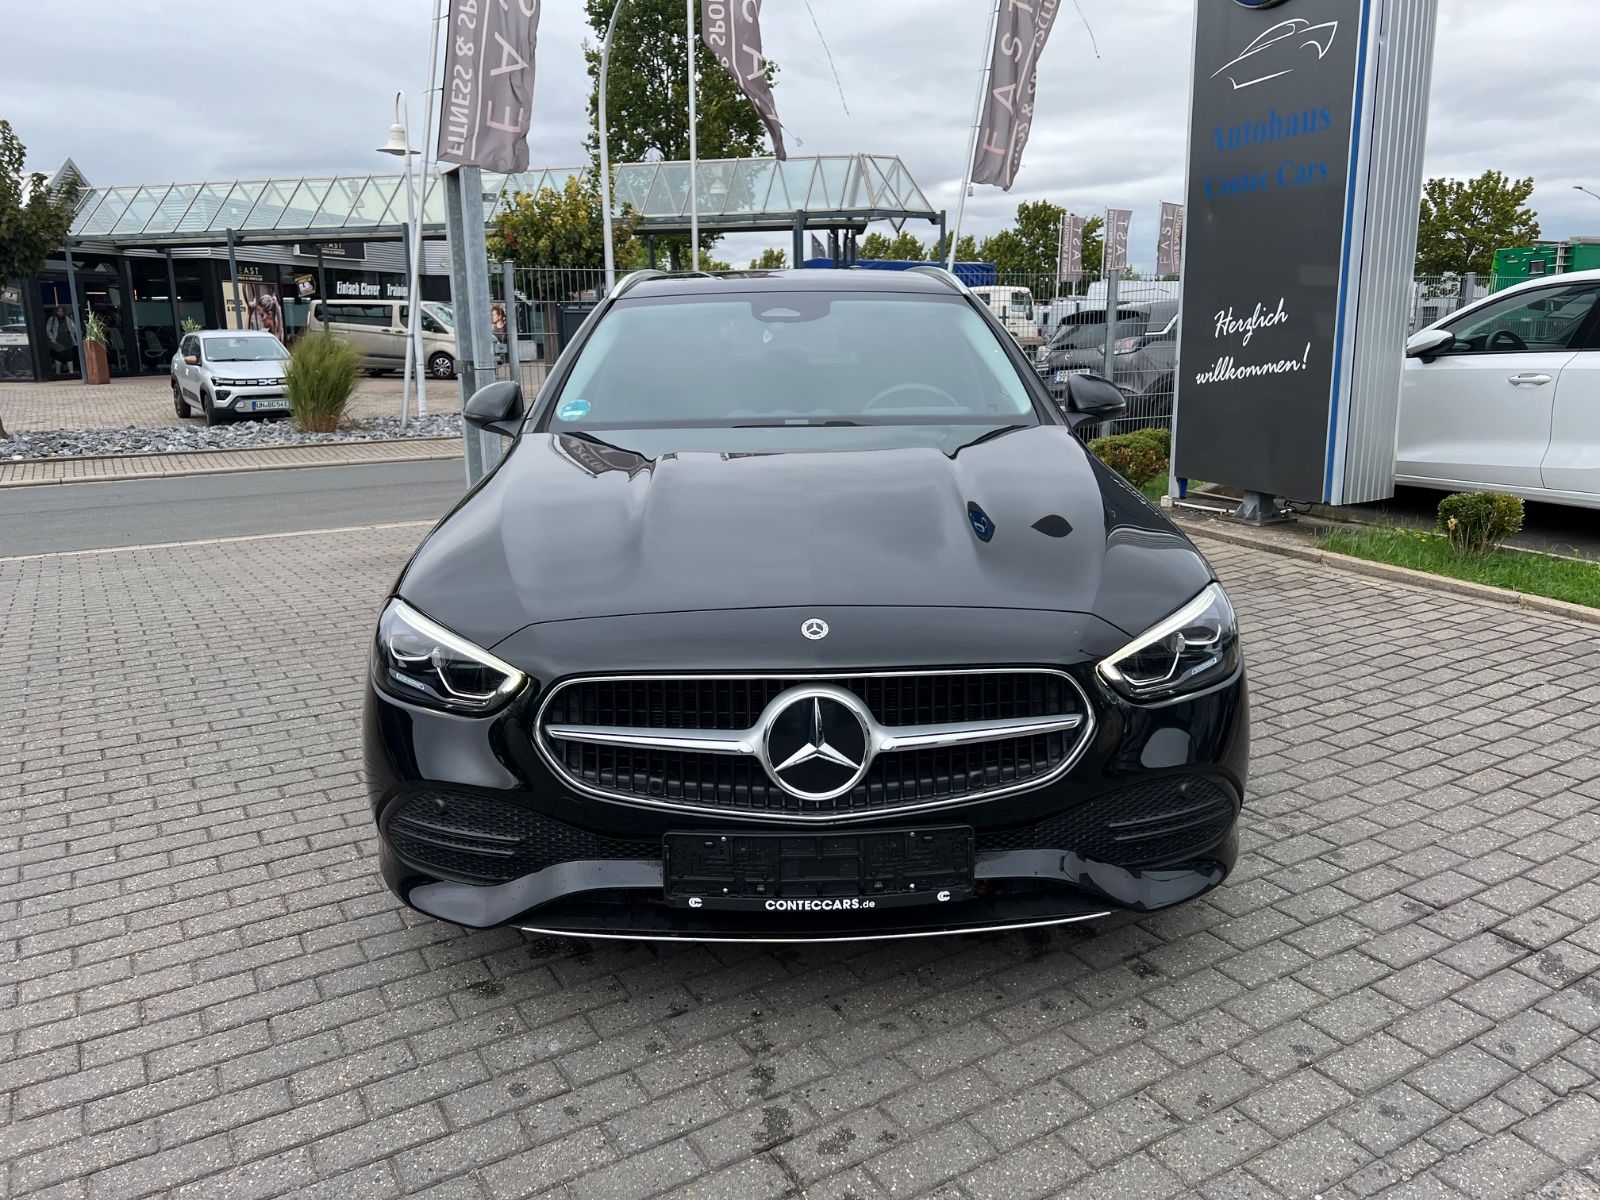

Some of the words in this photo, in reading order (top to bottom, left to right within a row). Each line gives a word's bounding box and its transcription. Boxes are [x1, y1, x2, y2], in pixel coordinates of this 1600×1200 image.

[1208, 104, 1333, 156] Autohaus
[1276, 159, 1329, 188] Cars
[336, 281, 360, 295] Einfach
[361, 283, 380, 296] Clever
[1214, 297, 1288, 346] Herzlich
[1196, 342, 1311, 384] willkommen!
[765, 898, 876, 911] CONTECCARS.de
